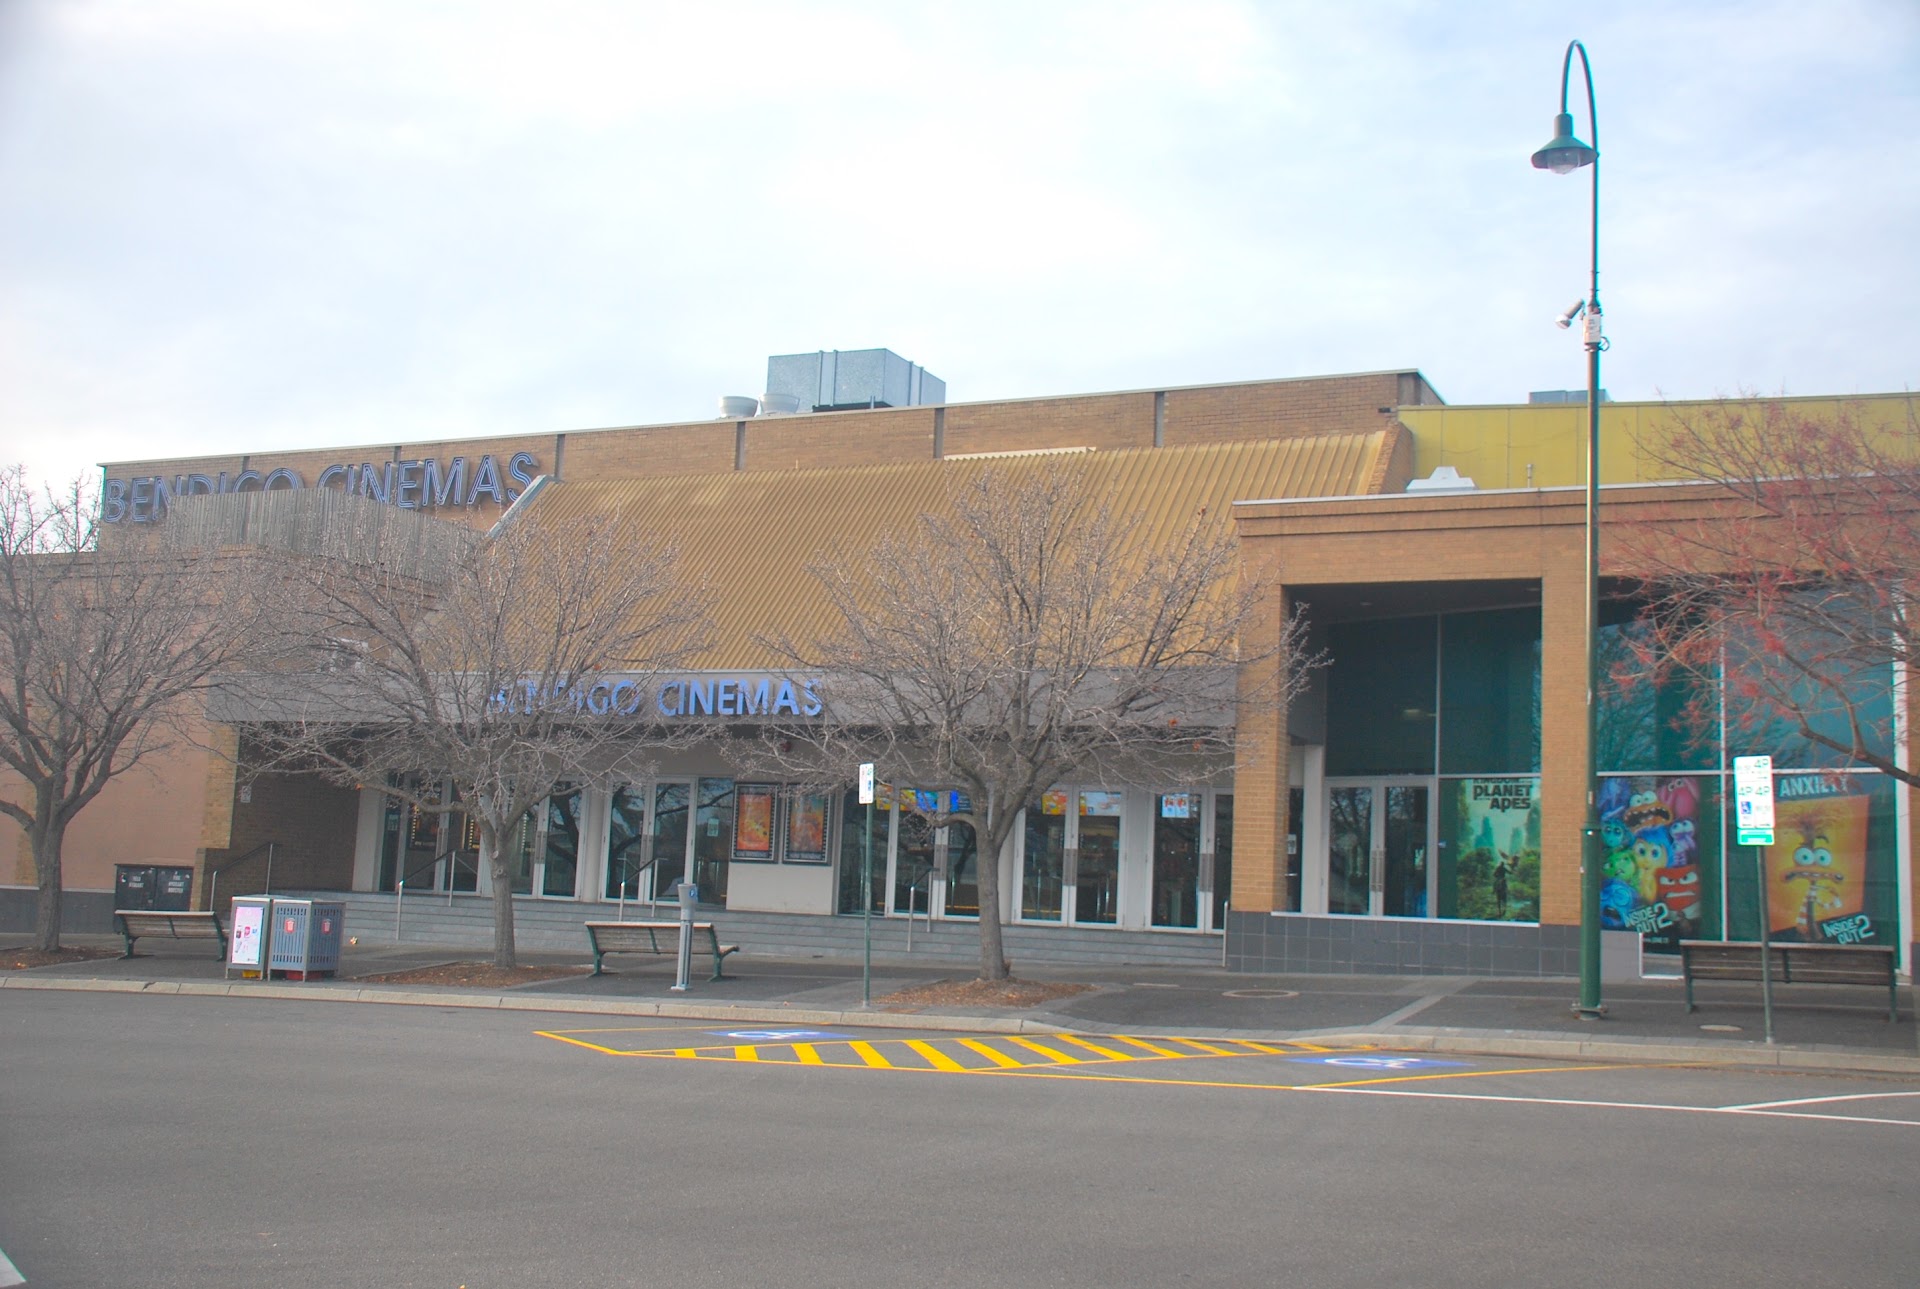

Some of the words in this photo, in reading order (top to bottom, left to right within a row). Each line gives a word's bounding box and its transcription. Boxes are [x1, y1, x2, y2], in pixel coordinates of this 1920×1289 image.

[317, 451, 535, 508] CINEMAS
[657, 679, 822, 716] CINEMAS
[1473, 784, 1532, 800] PLANET
[1490, 797, 1531, 812] APES
[1636, 918, 1658, 934] OUT
[1654, 902, 1674, 929] 2
[1837, 927, 1860, 945] OUT
[1855, 914, 1875, 939] 2
